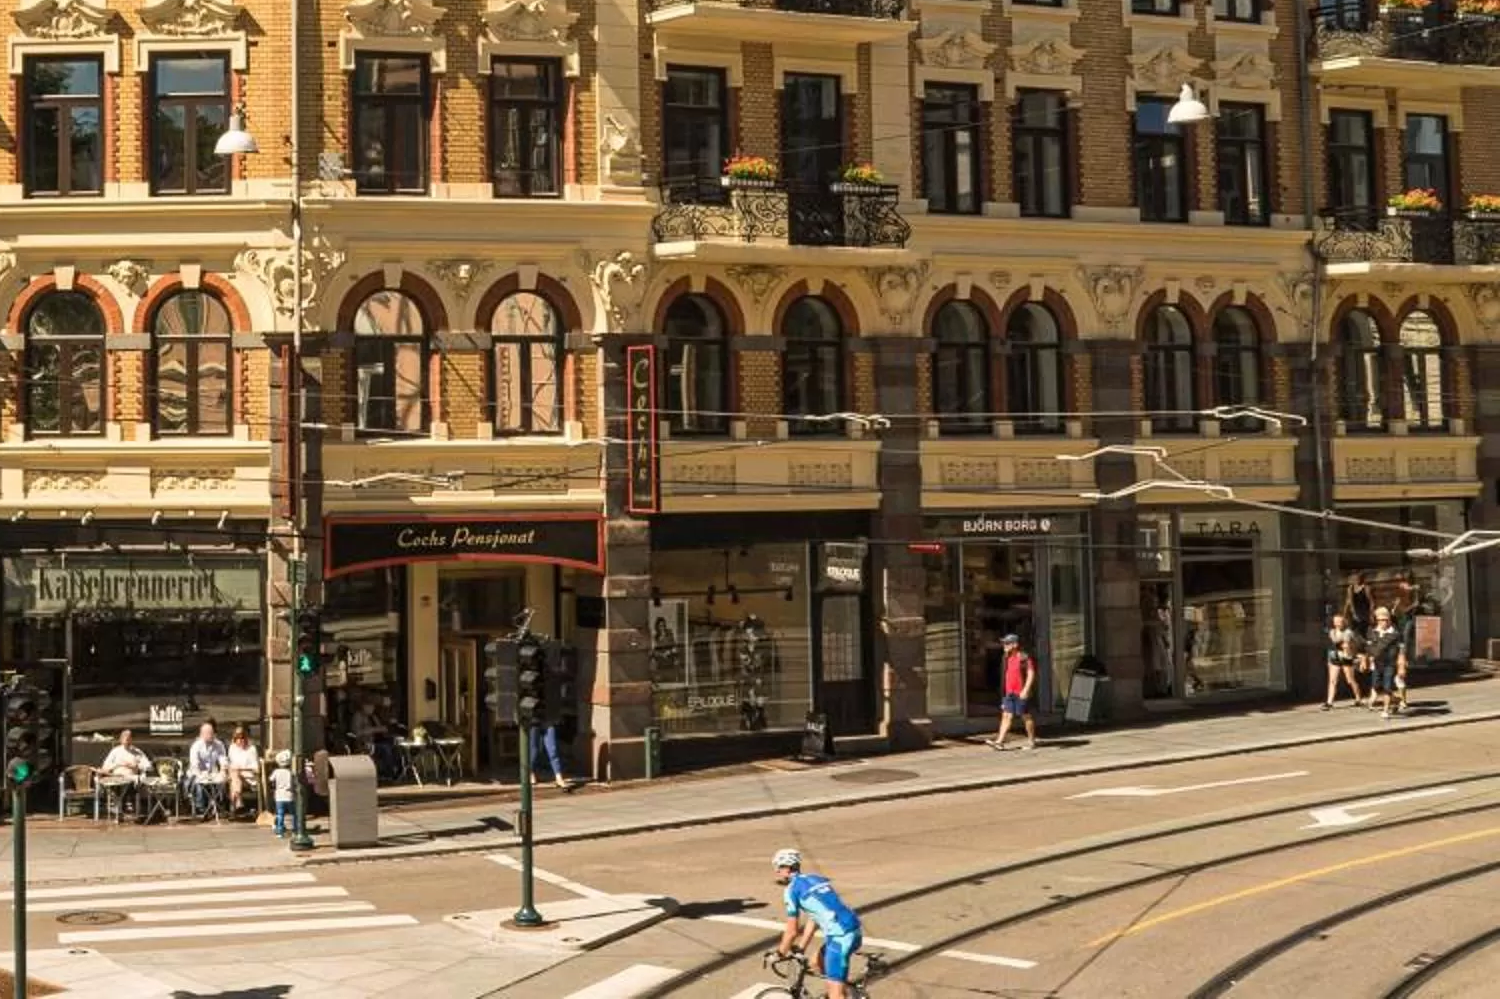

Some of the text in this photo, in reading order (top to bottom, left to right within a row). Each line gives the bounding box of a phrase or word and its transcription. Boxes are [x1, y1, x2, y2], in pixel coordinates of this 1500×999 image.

[397, 527, 536, 549] Cochs Pensjonat
[1195, 521, 1262, 537] TARA
